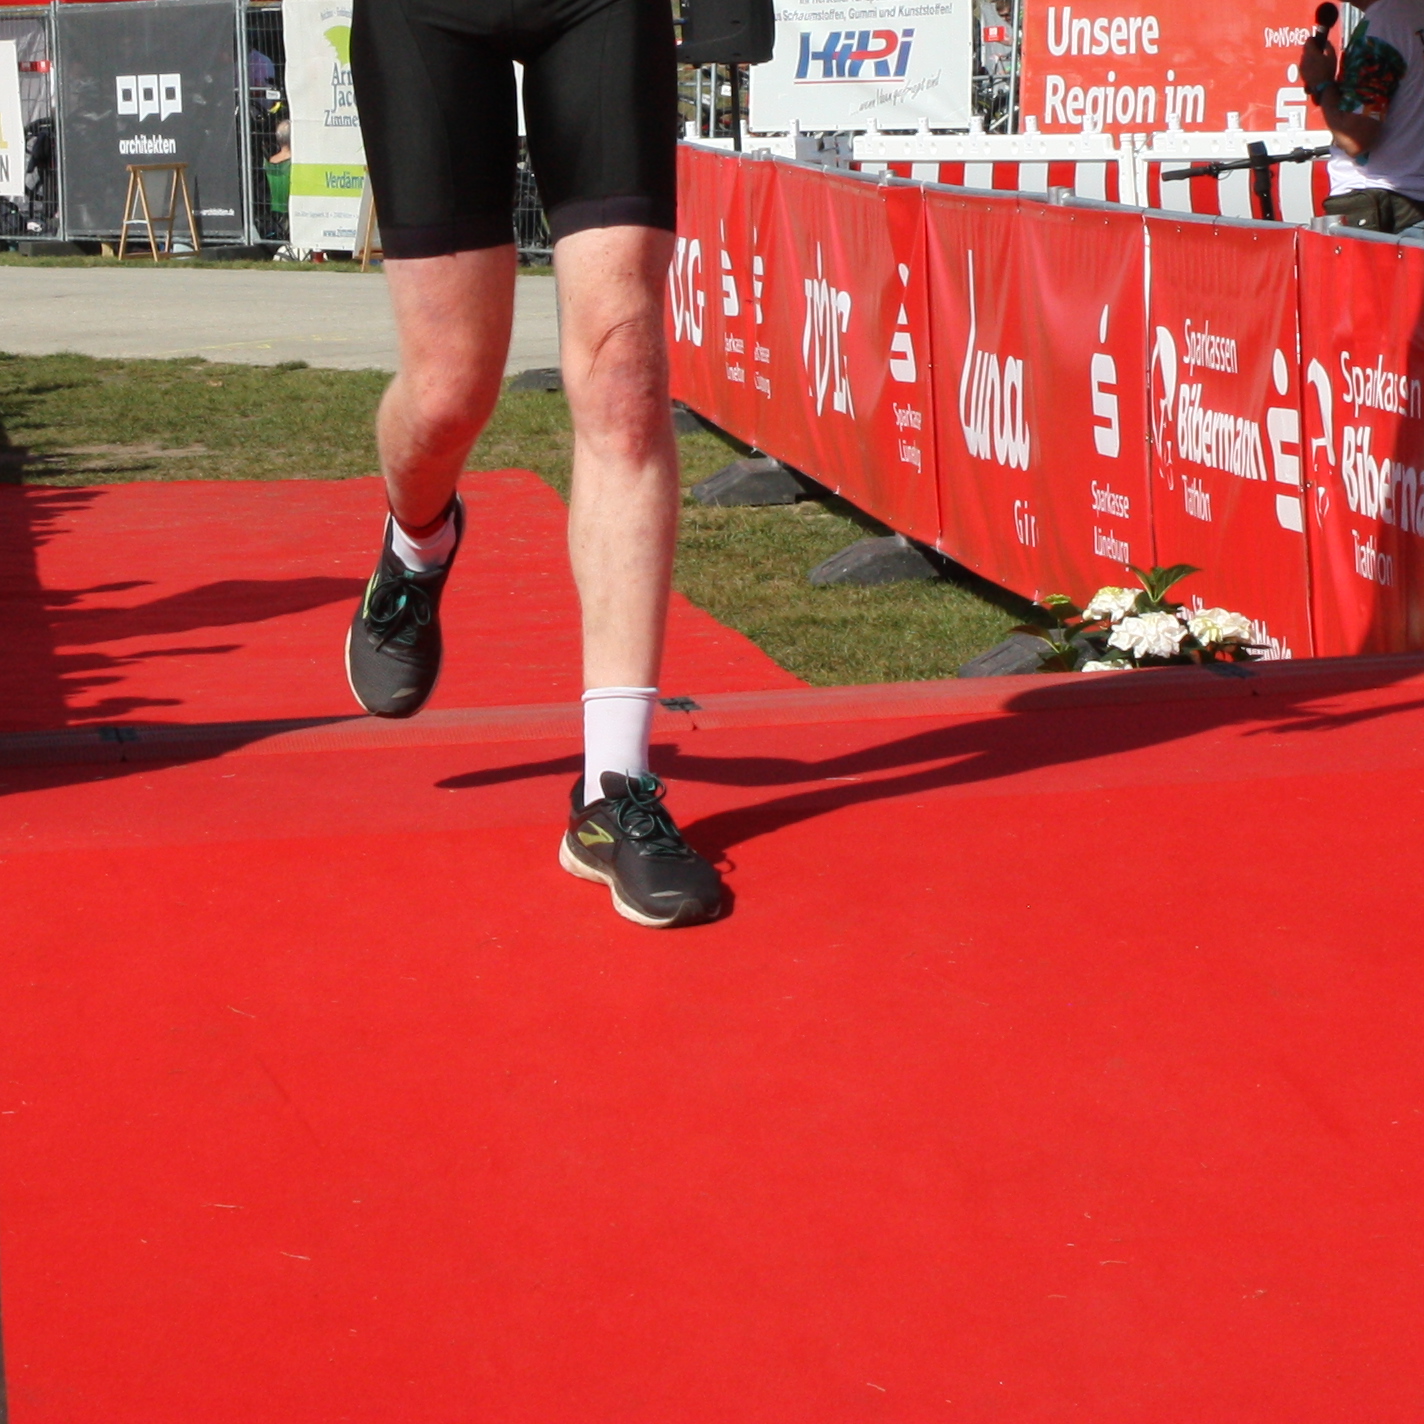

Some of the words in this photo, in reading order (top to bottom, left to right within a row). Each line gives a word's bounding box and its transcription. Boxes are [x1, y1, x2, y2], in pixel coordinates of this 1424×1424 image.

[848, 6, 878, 19] Gummi
[879, 5, 896, 18] und
[1047, 6, 1160, 57] Unsere
[324, 109, 360, 127] Zimme
[330, 84, 356, 113] Jac
[1044, 70, 1157, 133] Region
[1164, 69, 1206, 125] im
[119, 133, 177, 155] architekten
[1182, 318, 1239, 377] Sparkassen
[1177, 383, 1268, 482] Bibermann
[1091, 479, 1130, 519] Sparkasse
[1014, 499, 1039, 548] Gir
